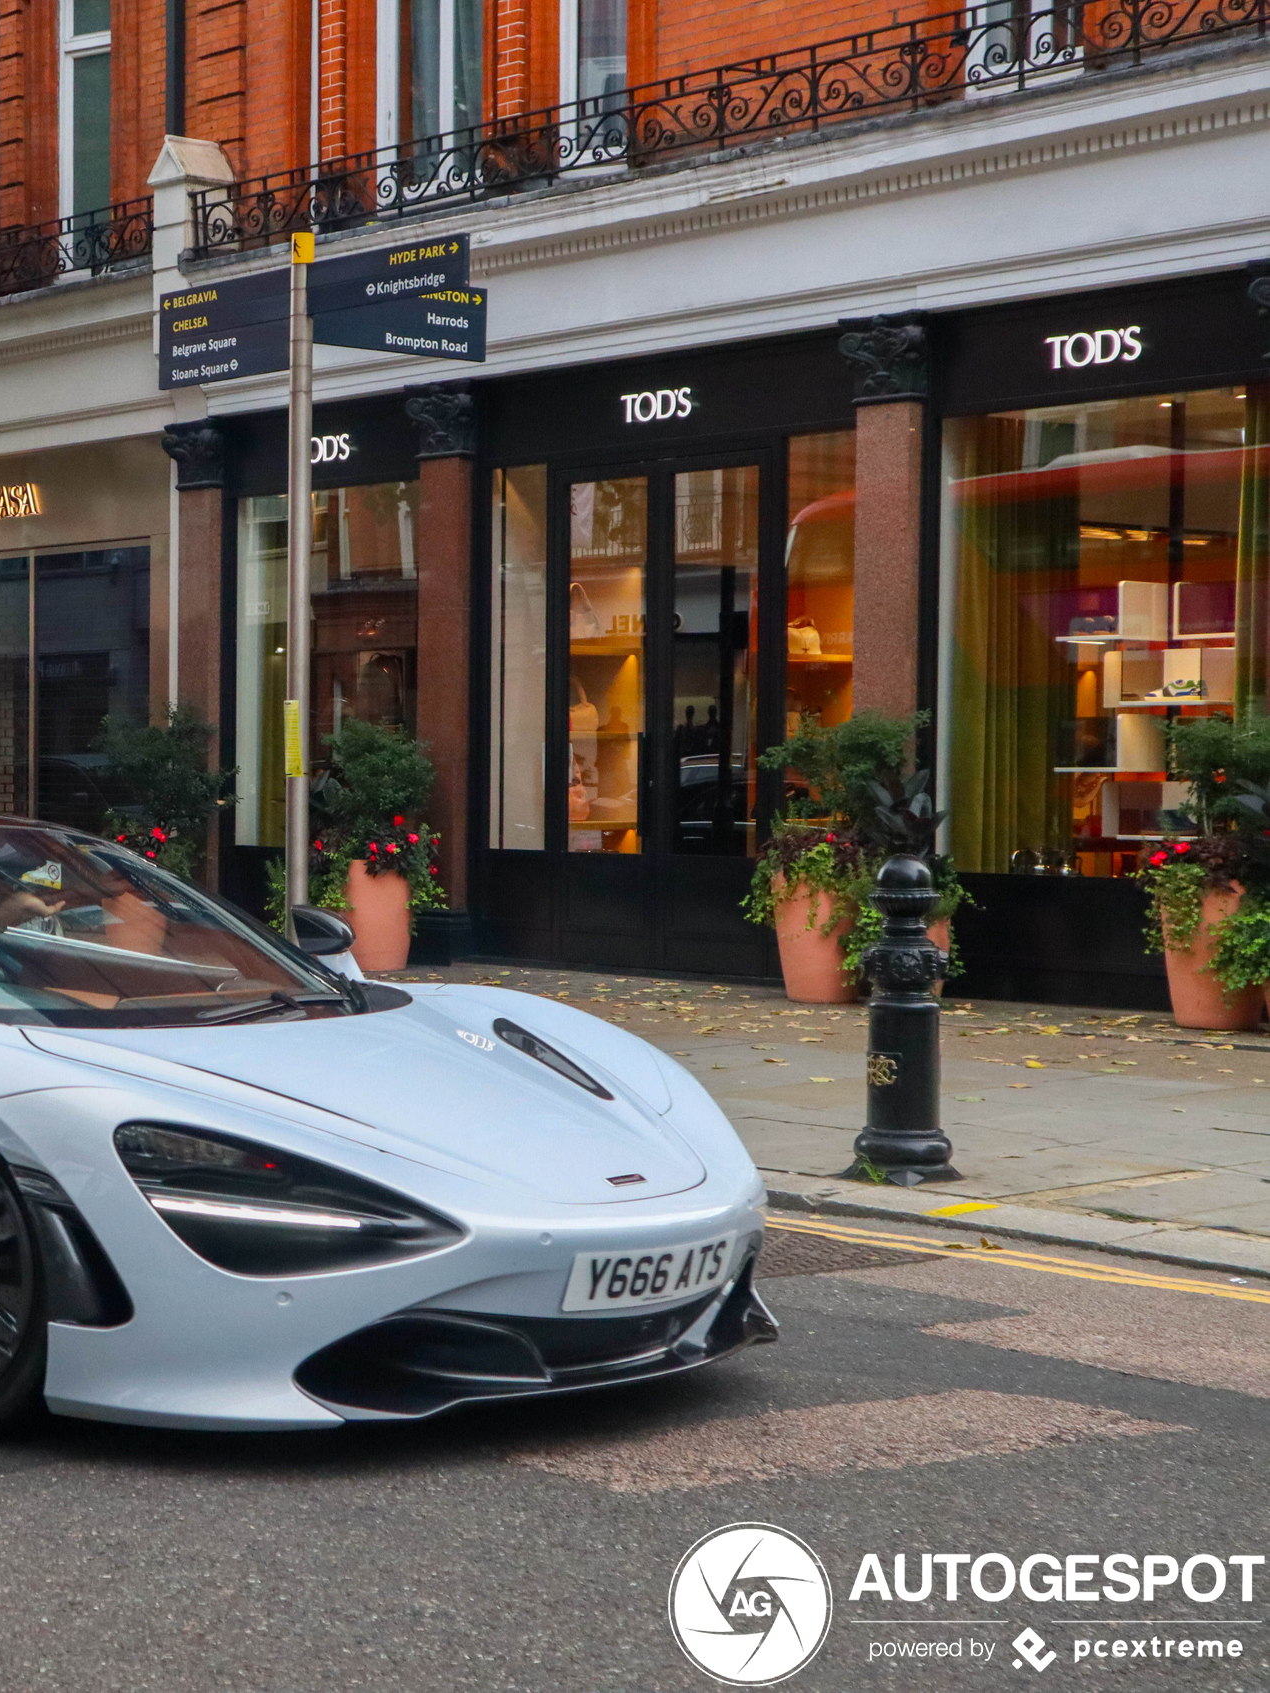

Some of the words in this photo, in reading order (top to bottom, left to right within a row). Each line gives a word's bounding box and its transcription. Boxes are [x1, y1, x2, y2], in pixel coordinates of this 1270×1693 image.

[389, 250, 417, 266] HYDE
[418, 244, 446, 261] PARK
[376, 272, 446, 295] Knightsbridge
[172, 289, 218, 309] BELGRAVIA
[172, 316, 208, 332] CHELSEA
[427, 312, 469, 329] Harrods
[172, 341, 207, 357] Belgrave
[208, 336, 237, 354] Square
[385, 332, 438, 350] Brompton
[441, 338, 468, 353] Road
[1044, 325, 1142, 369] TOD'S
[172, 365, 199, 381] Sloane
[200, 361, 229, 378] Square
[620, 387, 692, 423] TOD'S
[310, 432, 350, 464] OD'S
[588, 1253, 673, 1300] Y666
[675, 1240, 727, 1290] ATS
